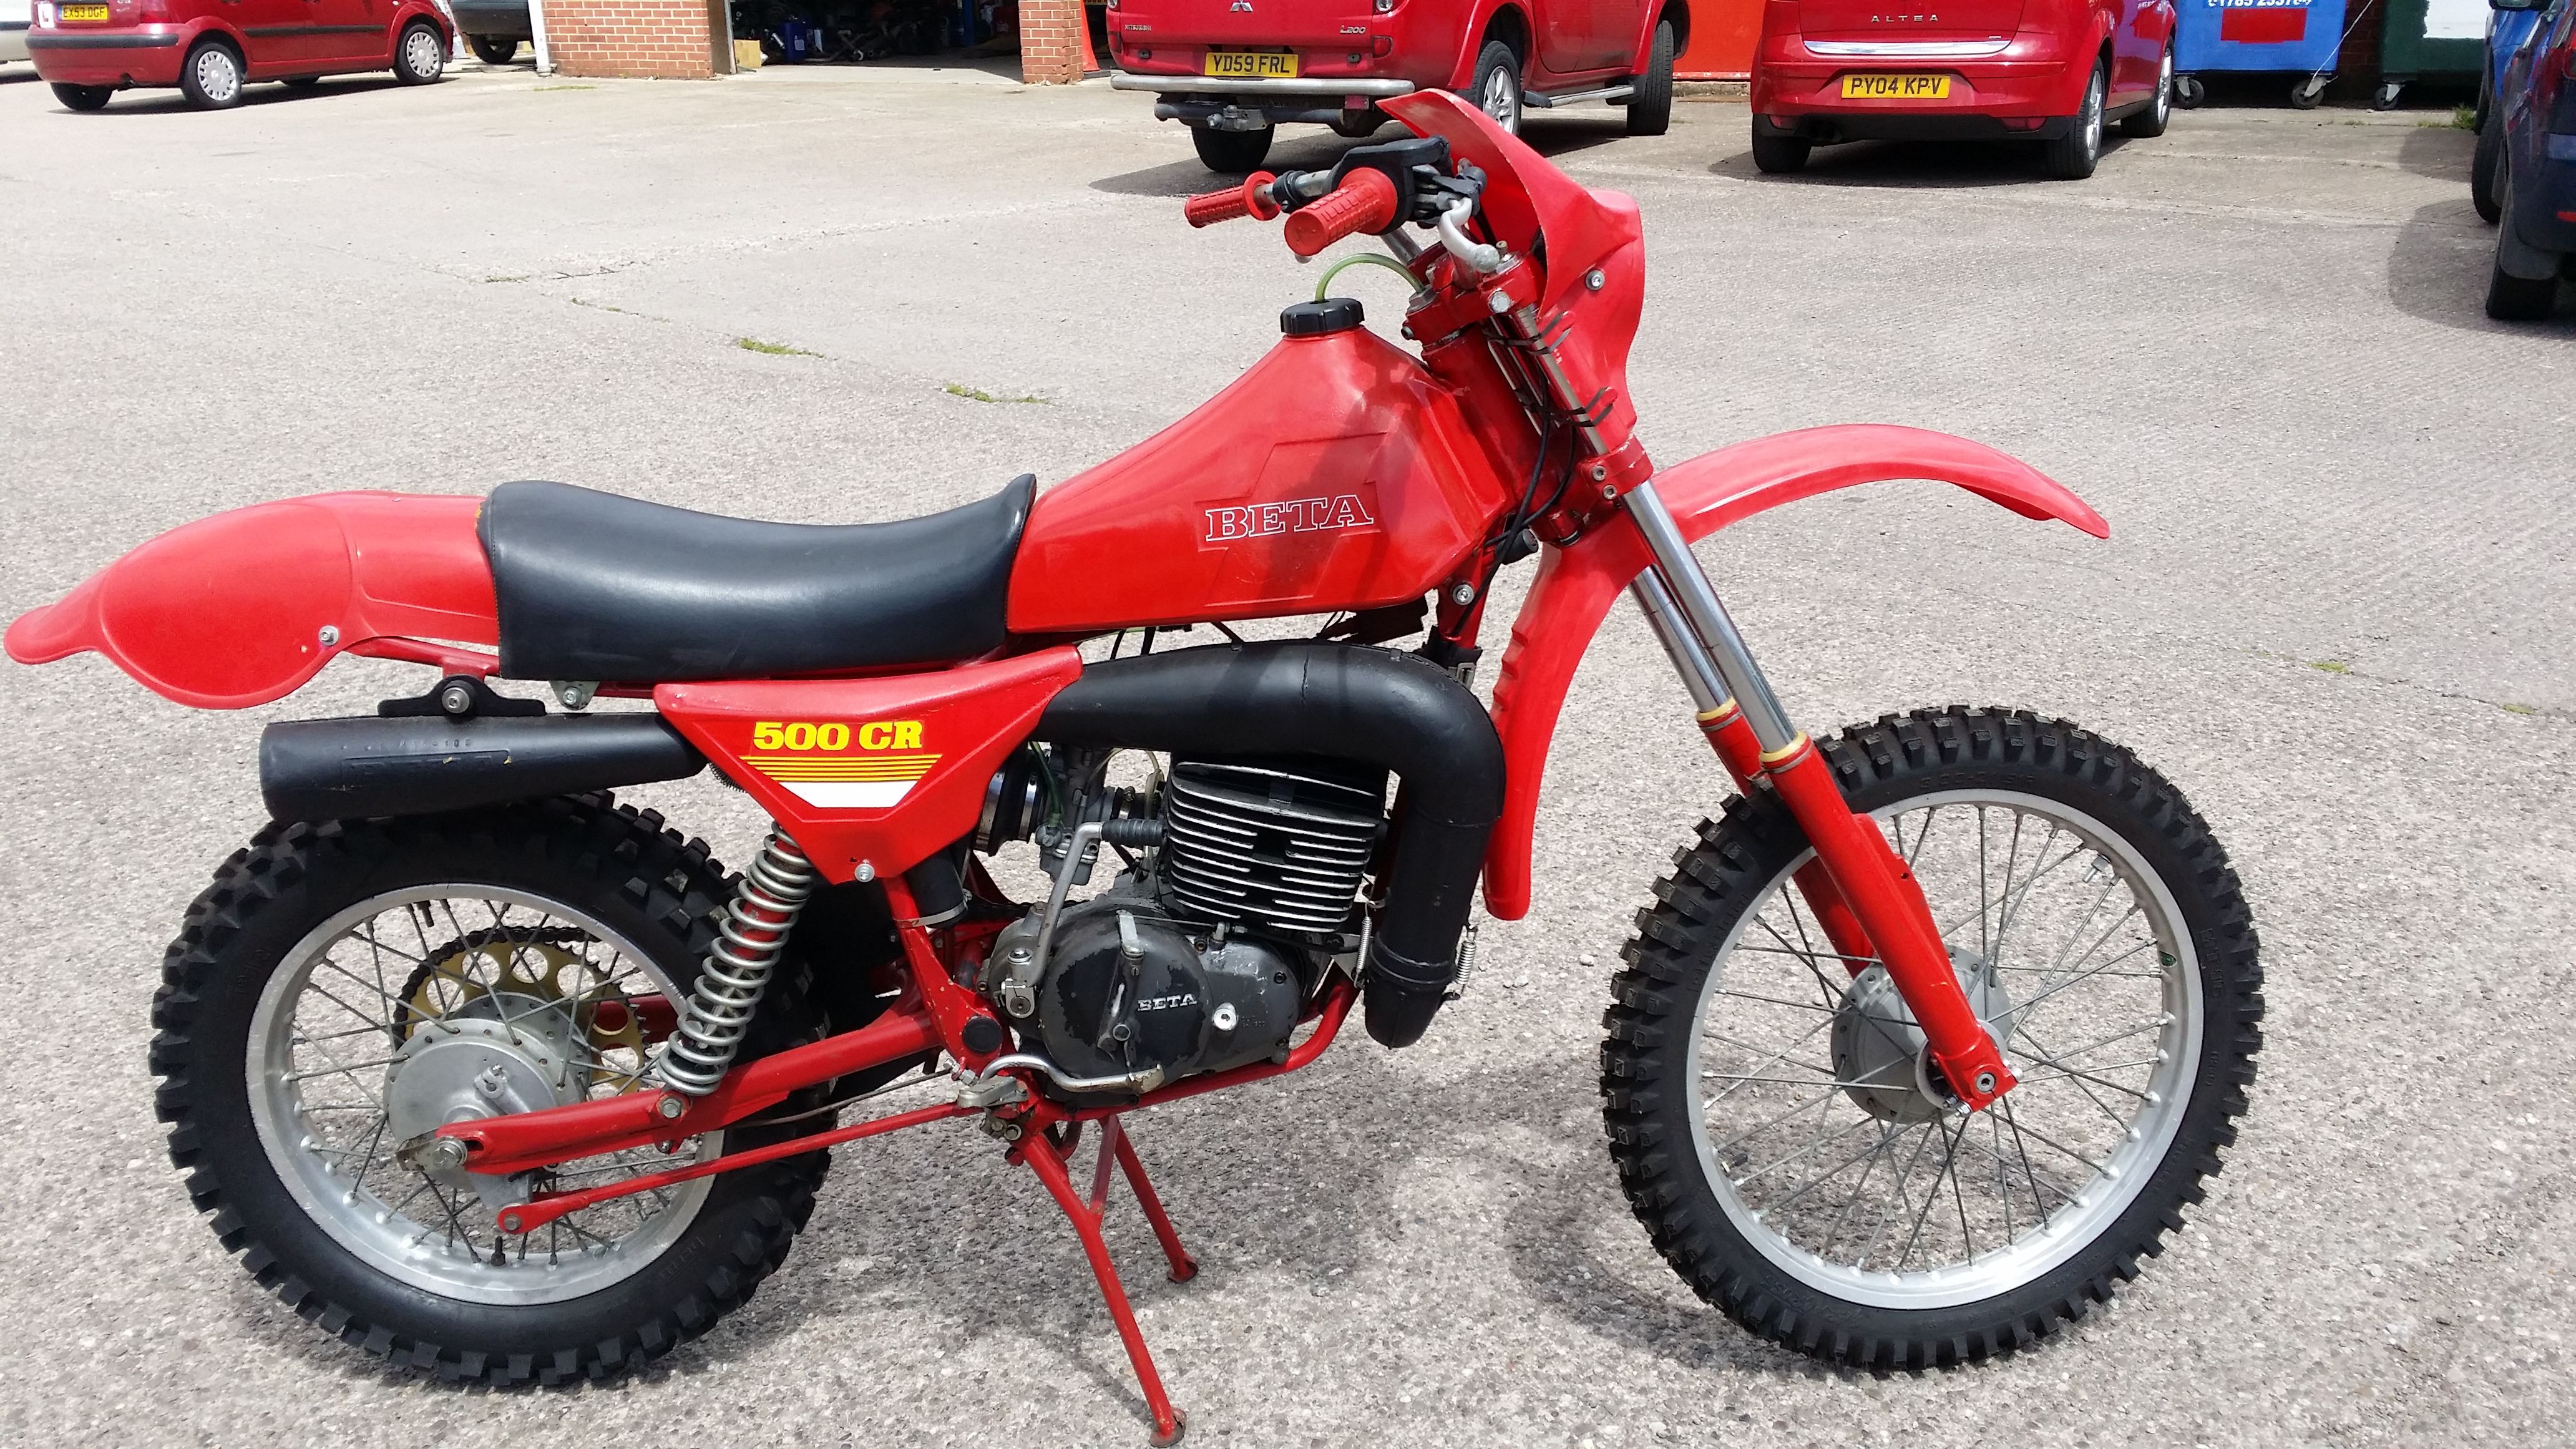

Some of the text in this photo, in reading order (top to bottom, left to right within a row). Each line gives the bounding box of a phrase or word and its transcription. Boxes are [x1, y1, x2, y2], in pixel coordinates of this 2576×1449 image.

[64, 7, 85, 17] EX53
[88, 7, 105, 17] DGF
[1871, 14, 1939, 22] ALTEA
[1340, 24, 1366, 34] L200
[1213, 55, 1290, 74] YD59 FRL
[1850, 77, 1943, 95] PY04 KPV
[1205, 494, 1374, 542] BETA
[753, 721, 923, 751] 500 CR
[1137, 993, 1198, 1012] BETA
